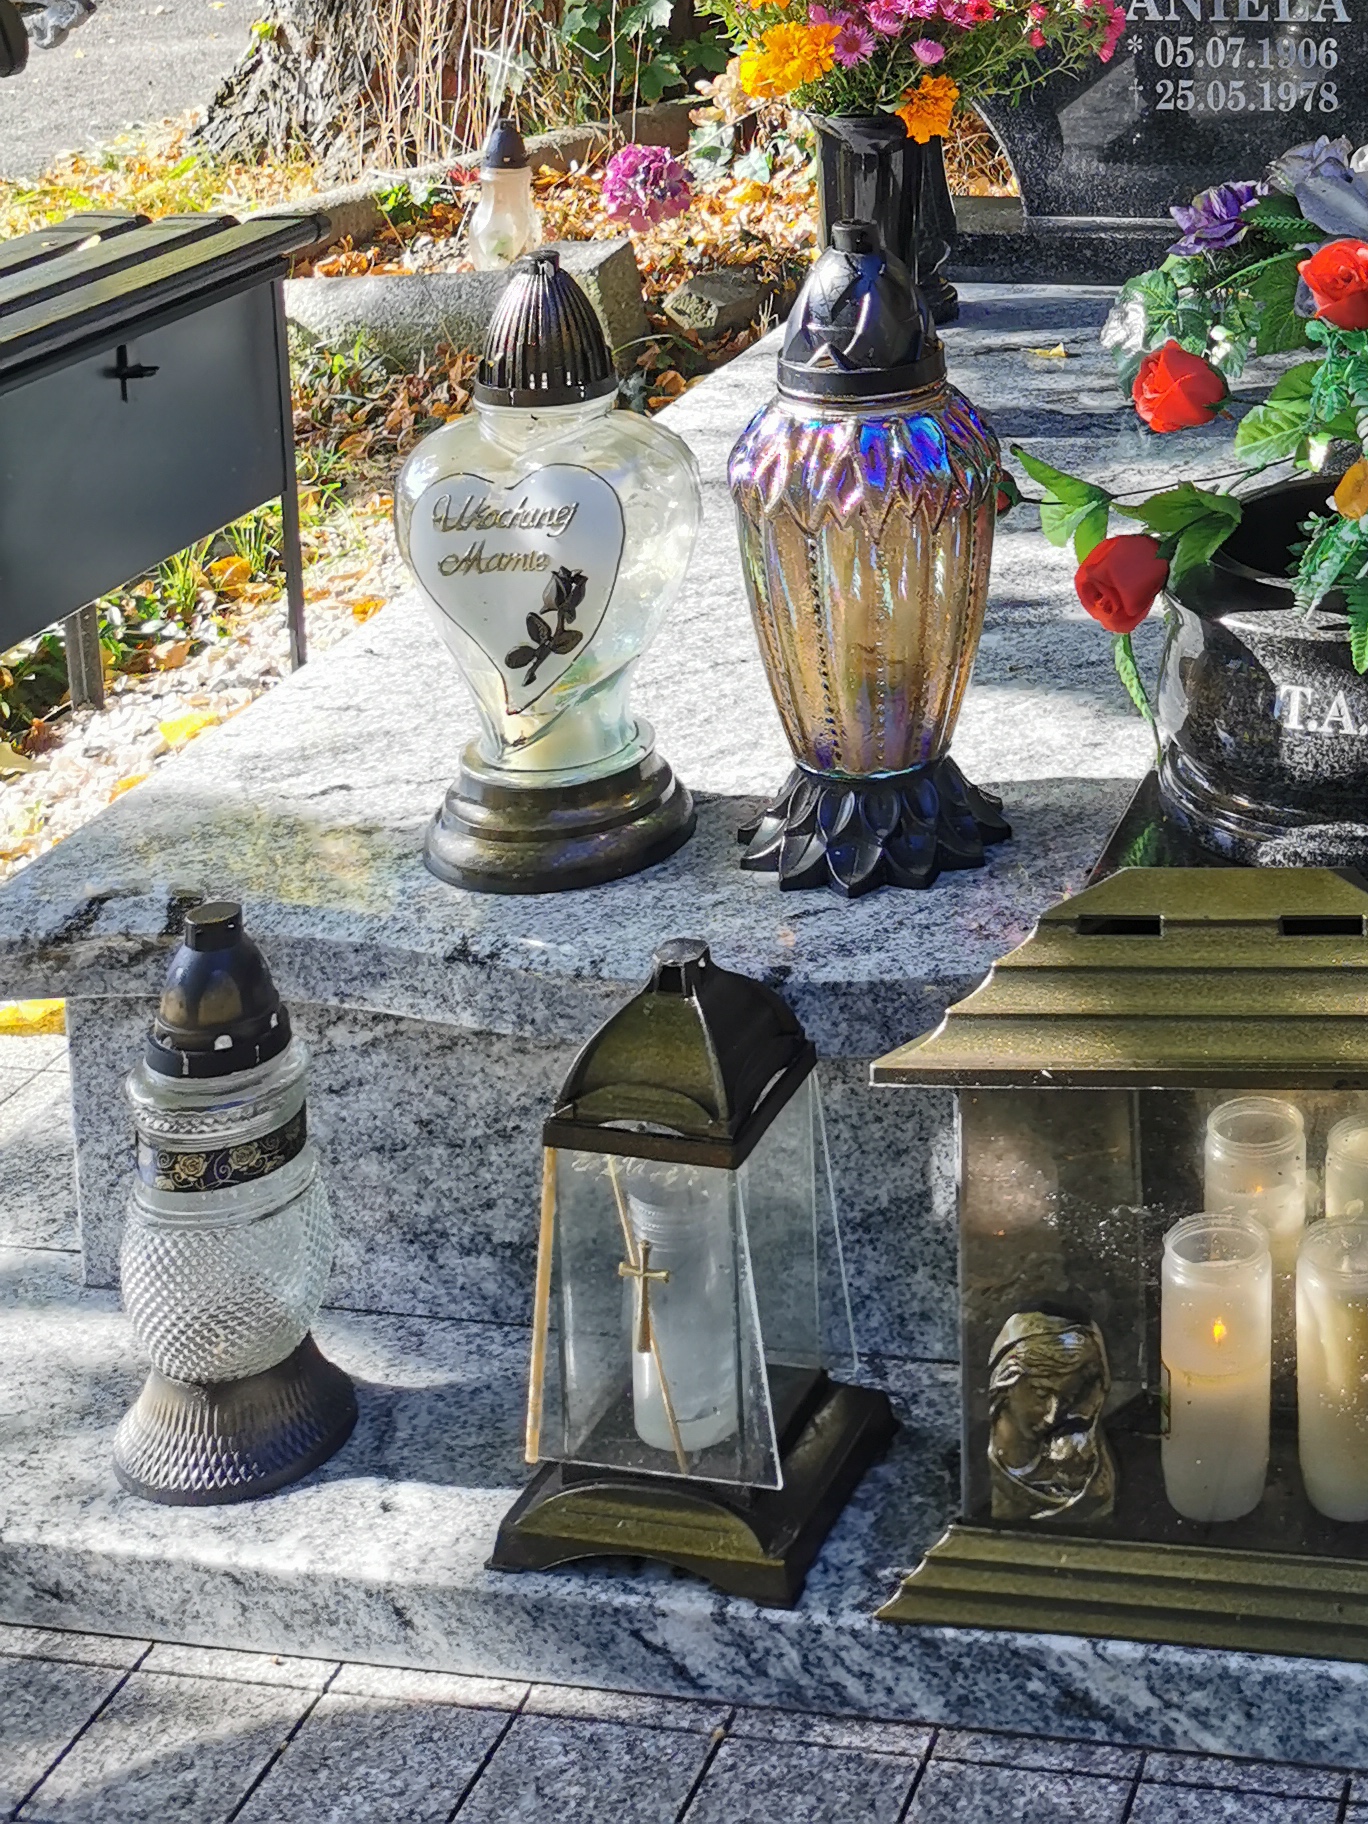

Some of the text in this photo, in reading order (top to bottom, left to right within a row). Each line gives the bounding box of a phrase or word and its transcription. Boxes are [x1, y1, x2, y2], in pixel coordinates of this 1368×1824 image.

[1154, 35, 1339, 70] 05.07.1906
[1155, 78, 1340, 113] 25.05.1978
[437, 539, 558, 577] Mamie
